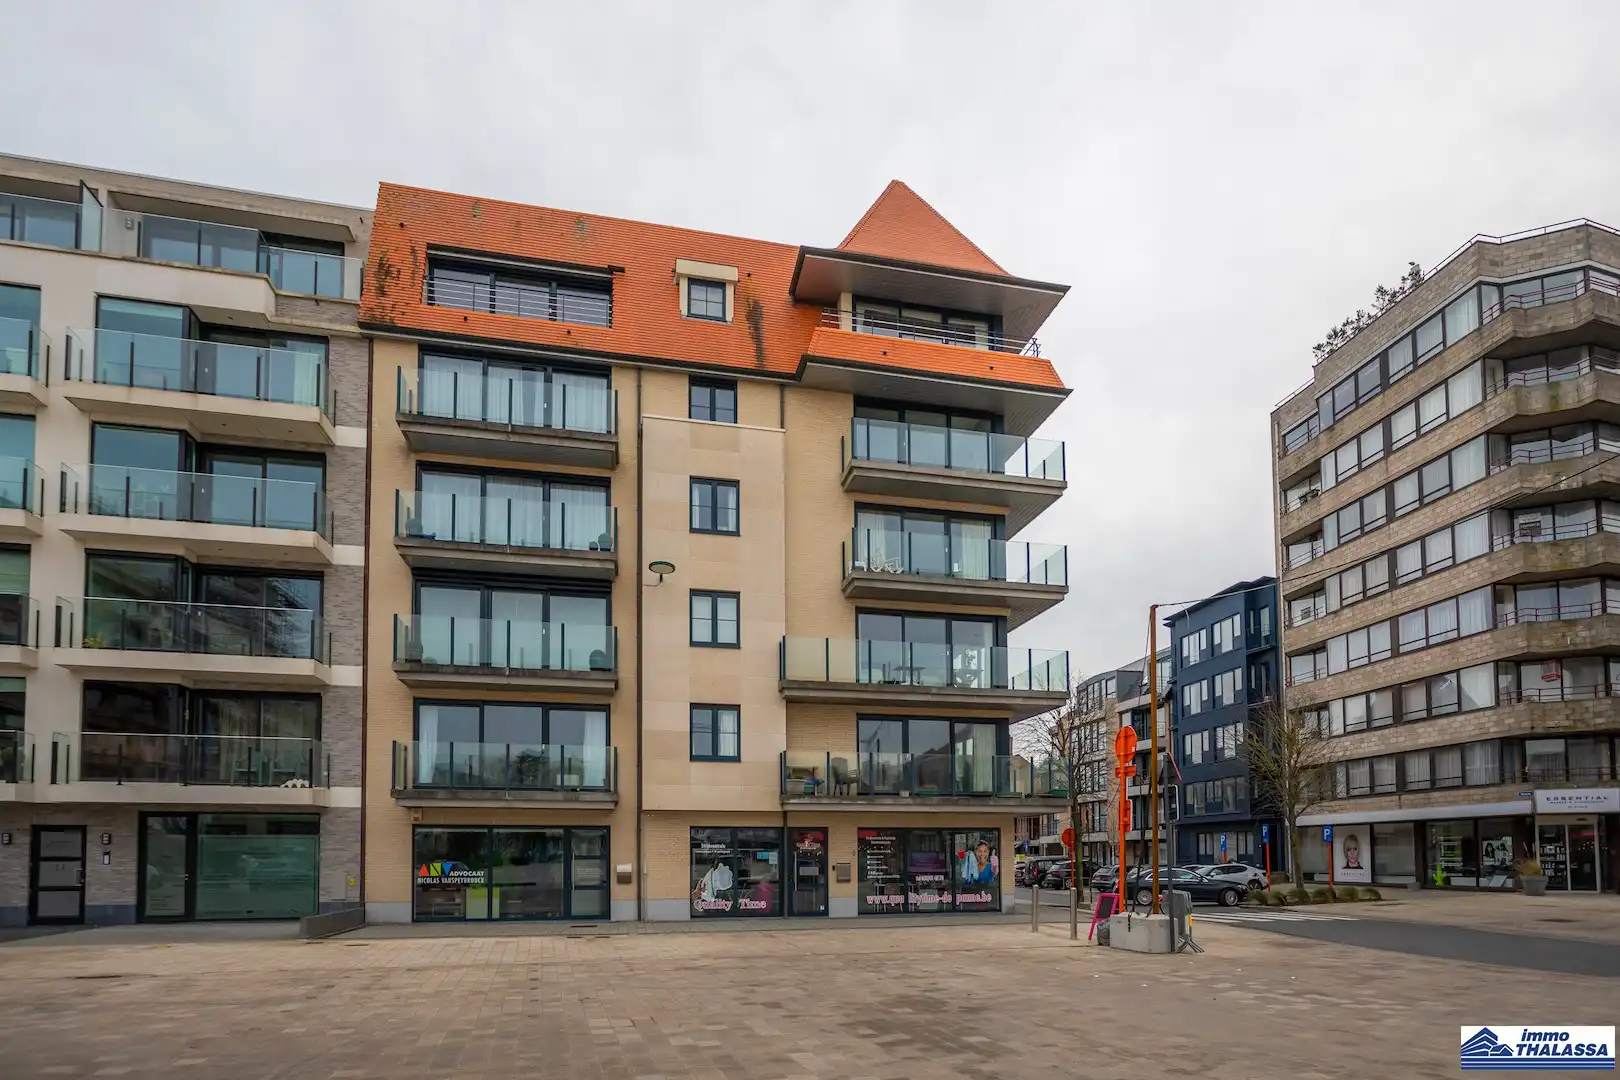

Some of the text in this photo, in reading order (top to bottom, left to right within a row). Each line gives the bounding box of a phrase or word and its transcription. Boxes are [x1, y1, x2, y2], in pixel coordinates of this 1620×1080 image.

[1323, 828, 1330, 840] P
[693, 898, 767, 912] Quality Time
